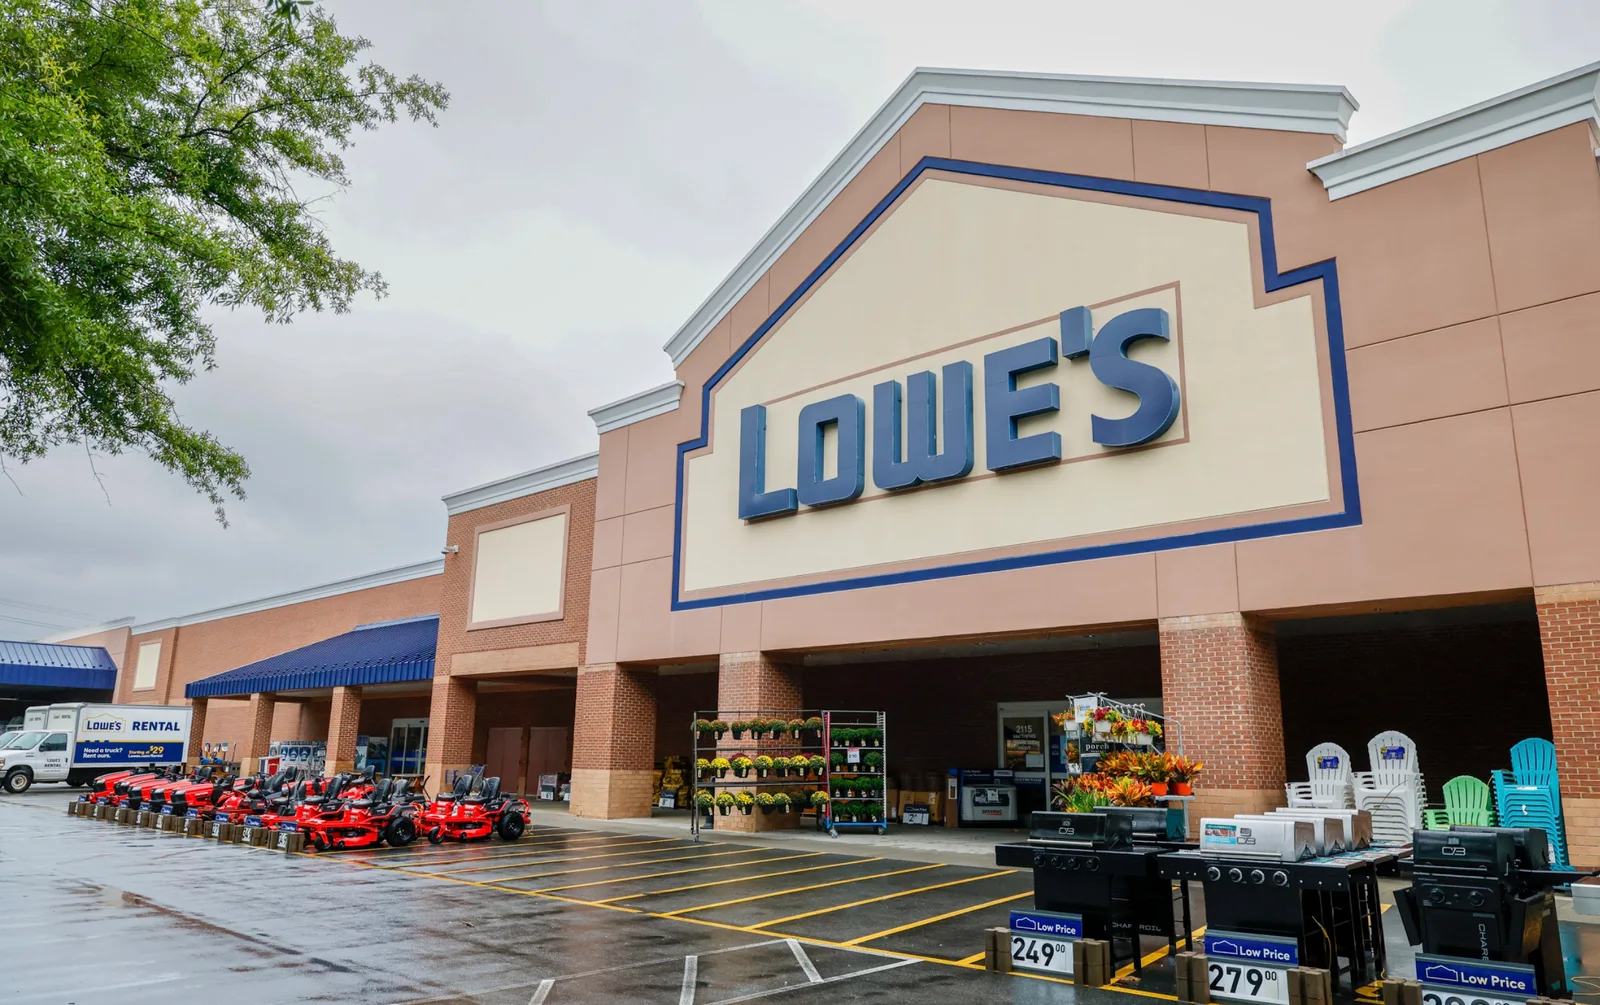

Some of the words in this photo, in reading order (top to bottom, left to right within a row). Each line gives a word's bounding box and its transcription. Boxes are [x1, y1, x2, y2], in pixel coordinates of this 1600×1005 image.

[738, 306, 1180, 520] LOWE'S
[86, 720, 122, 731] LOWE'S
[132, 721, 181, 732] RENTAL
[1016, 725, 1033, 733] 2115
[1037, 921, 1054, 932] Low
[1055, 924, 1076, 935] Price
[1239, 946, 1261, 958] Low
[1263, 948, 1290, 961] Price
[1209, 964, 1264, 996] 279
[1460, 972, 1488, 985] Low
[1491, 975, 1526, 990] Price
